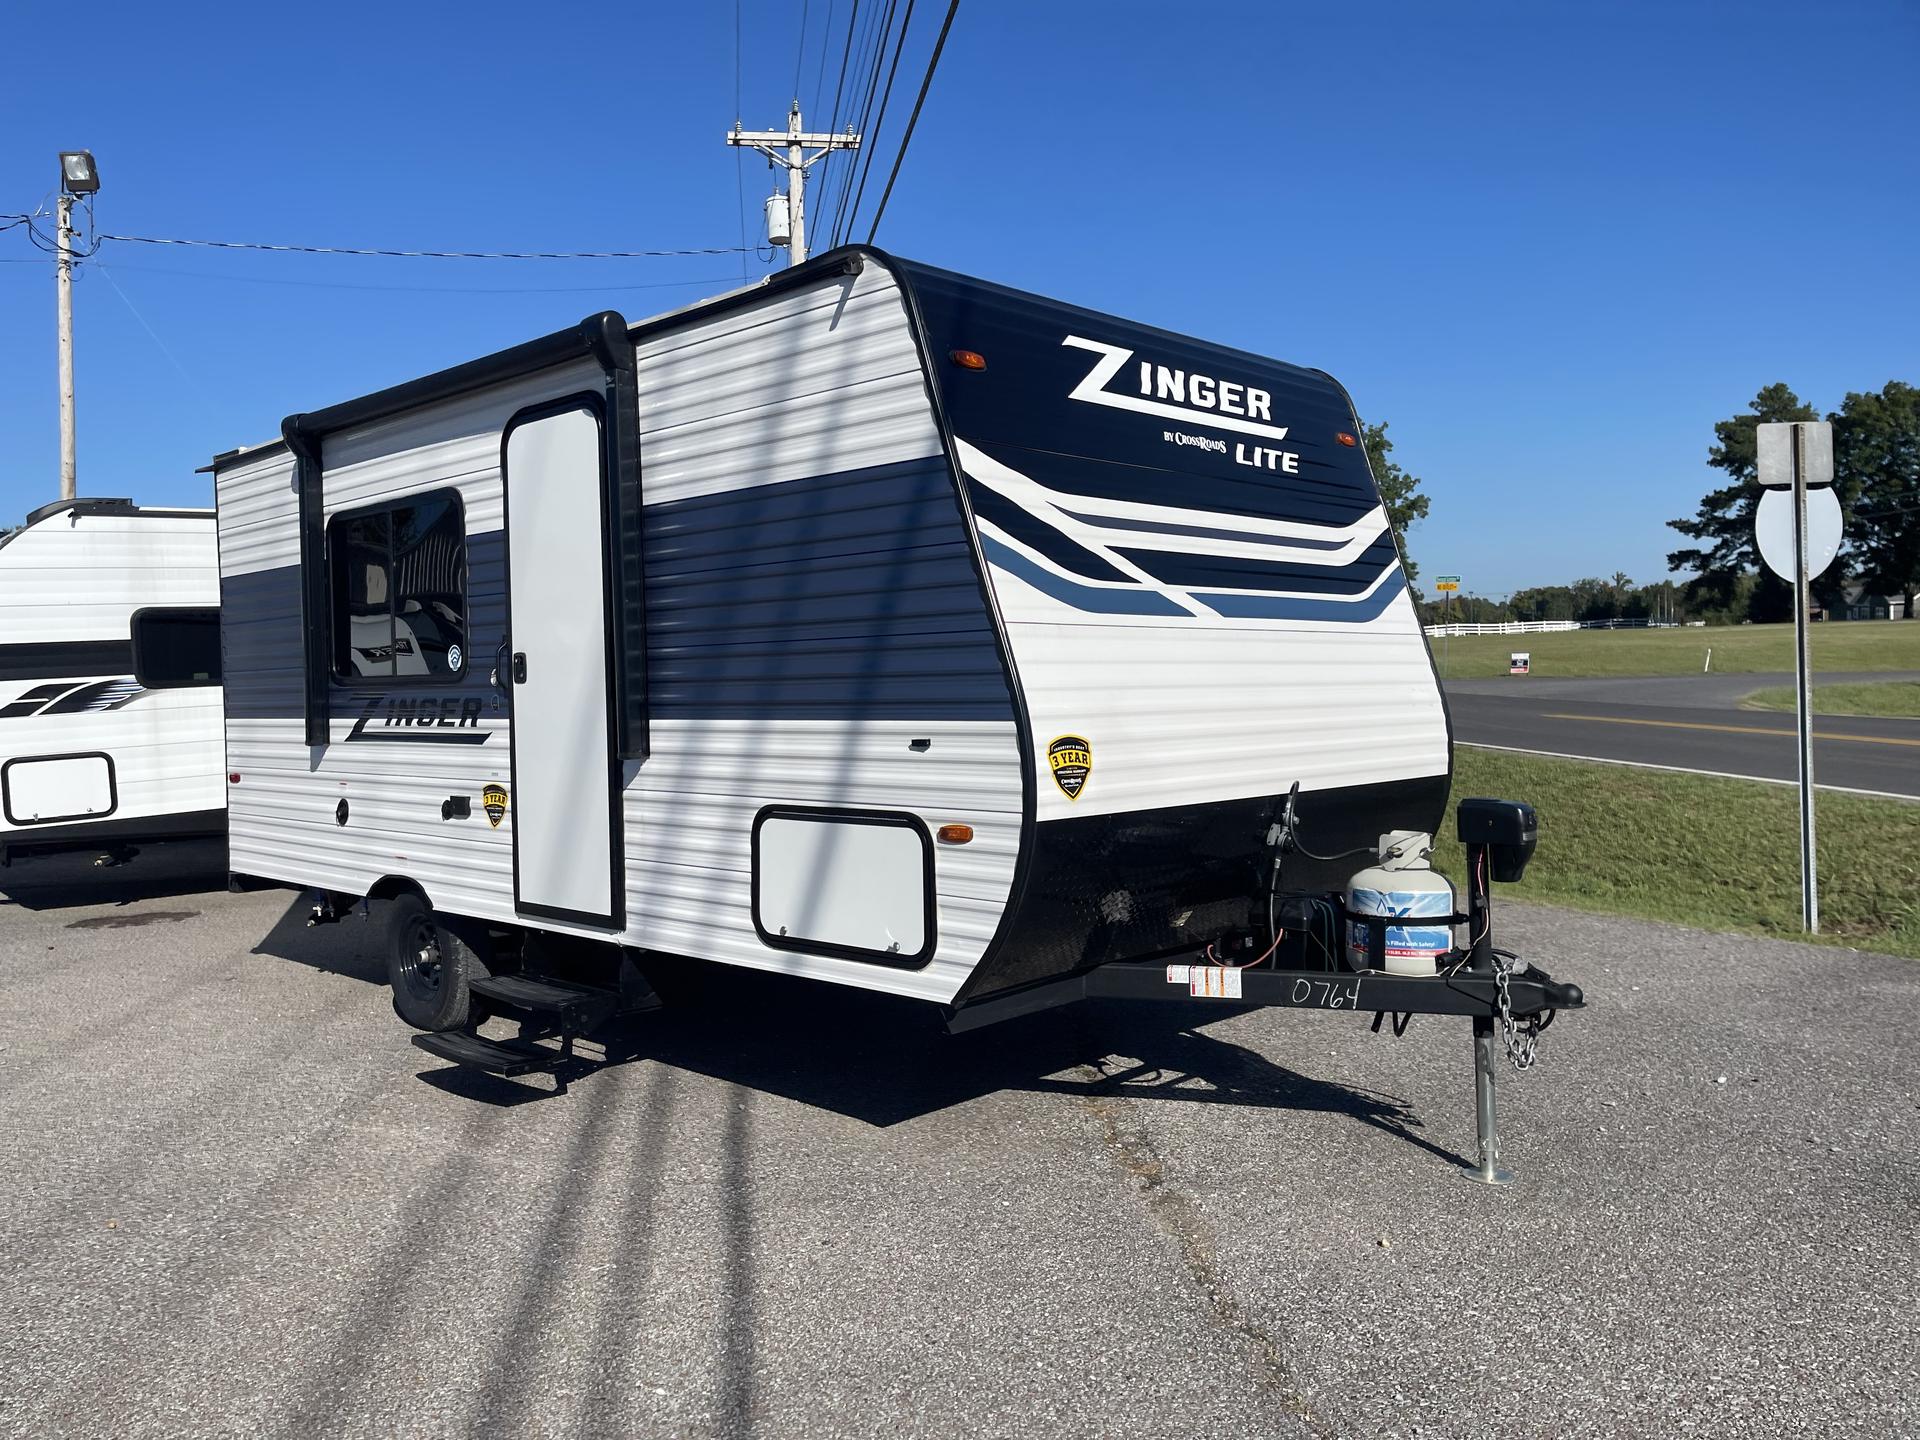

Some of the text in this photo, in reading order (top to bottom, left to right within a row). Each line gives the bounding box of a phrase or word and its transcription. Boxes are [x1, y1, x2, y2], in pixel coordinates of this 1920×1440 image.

[1061, 334, 1289, 440] ZINGER
[1163, 431, 1174, 442] BY
[1235, 443, 1299, 474] LITE
[344, 692, 493, 746] ZINGER
[1052, 752, 1088, 767] 3 YEAR
[1292, 979, 1362, 1010] 0764
